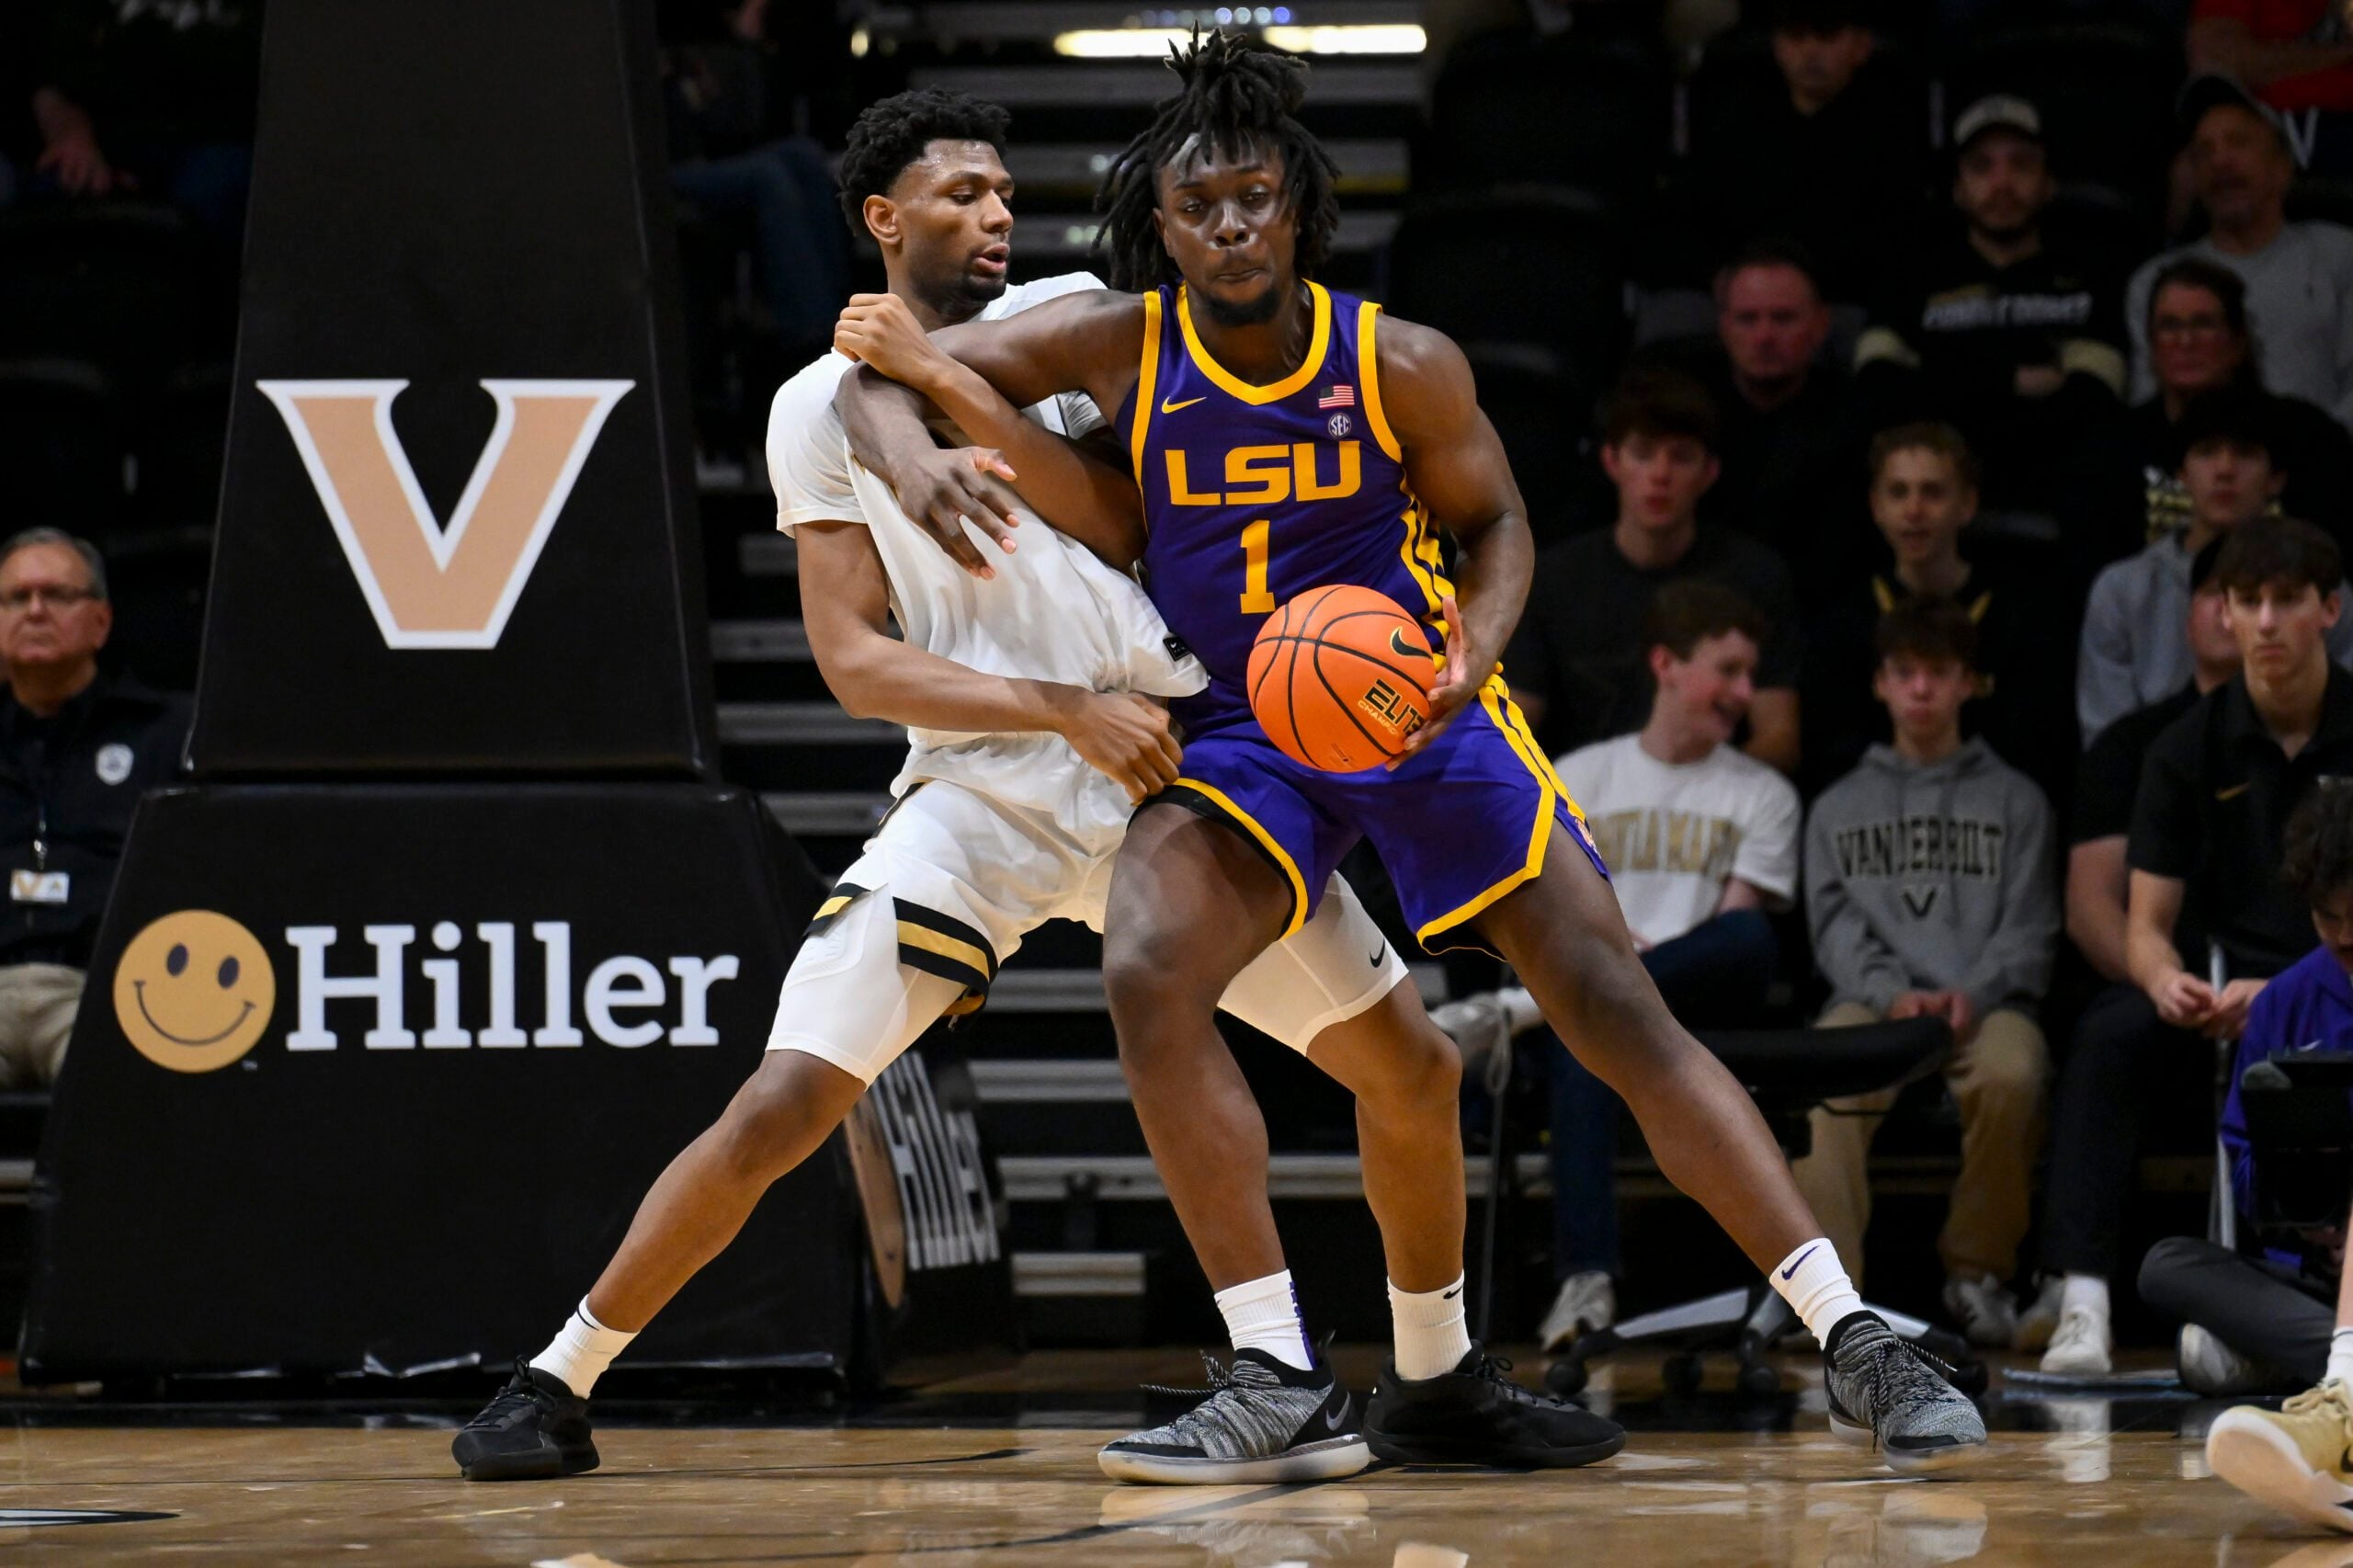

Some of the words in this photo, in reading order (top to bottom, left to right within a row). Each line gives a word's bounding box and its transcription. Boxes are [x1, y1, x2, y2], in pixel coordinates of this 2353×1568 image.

[1329, 414, 1350, 437] SEC
[1165, 440, 1362, 506] LSU
[255, 379, 636, 651] V
[1240, 519, 1277, 615] 1
[1836, 814, 2003, 880] VANDERBILT
[286, 921, 739, 1051] Hiller
